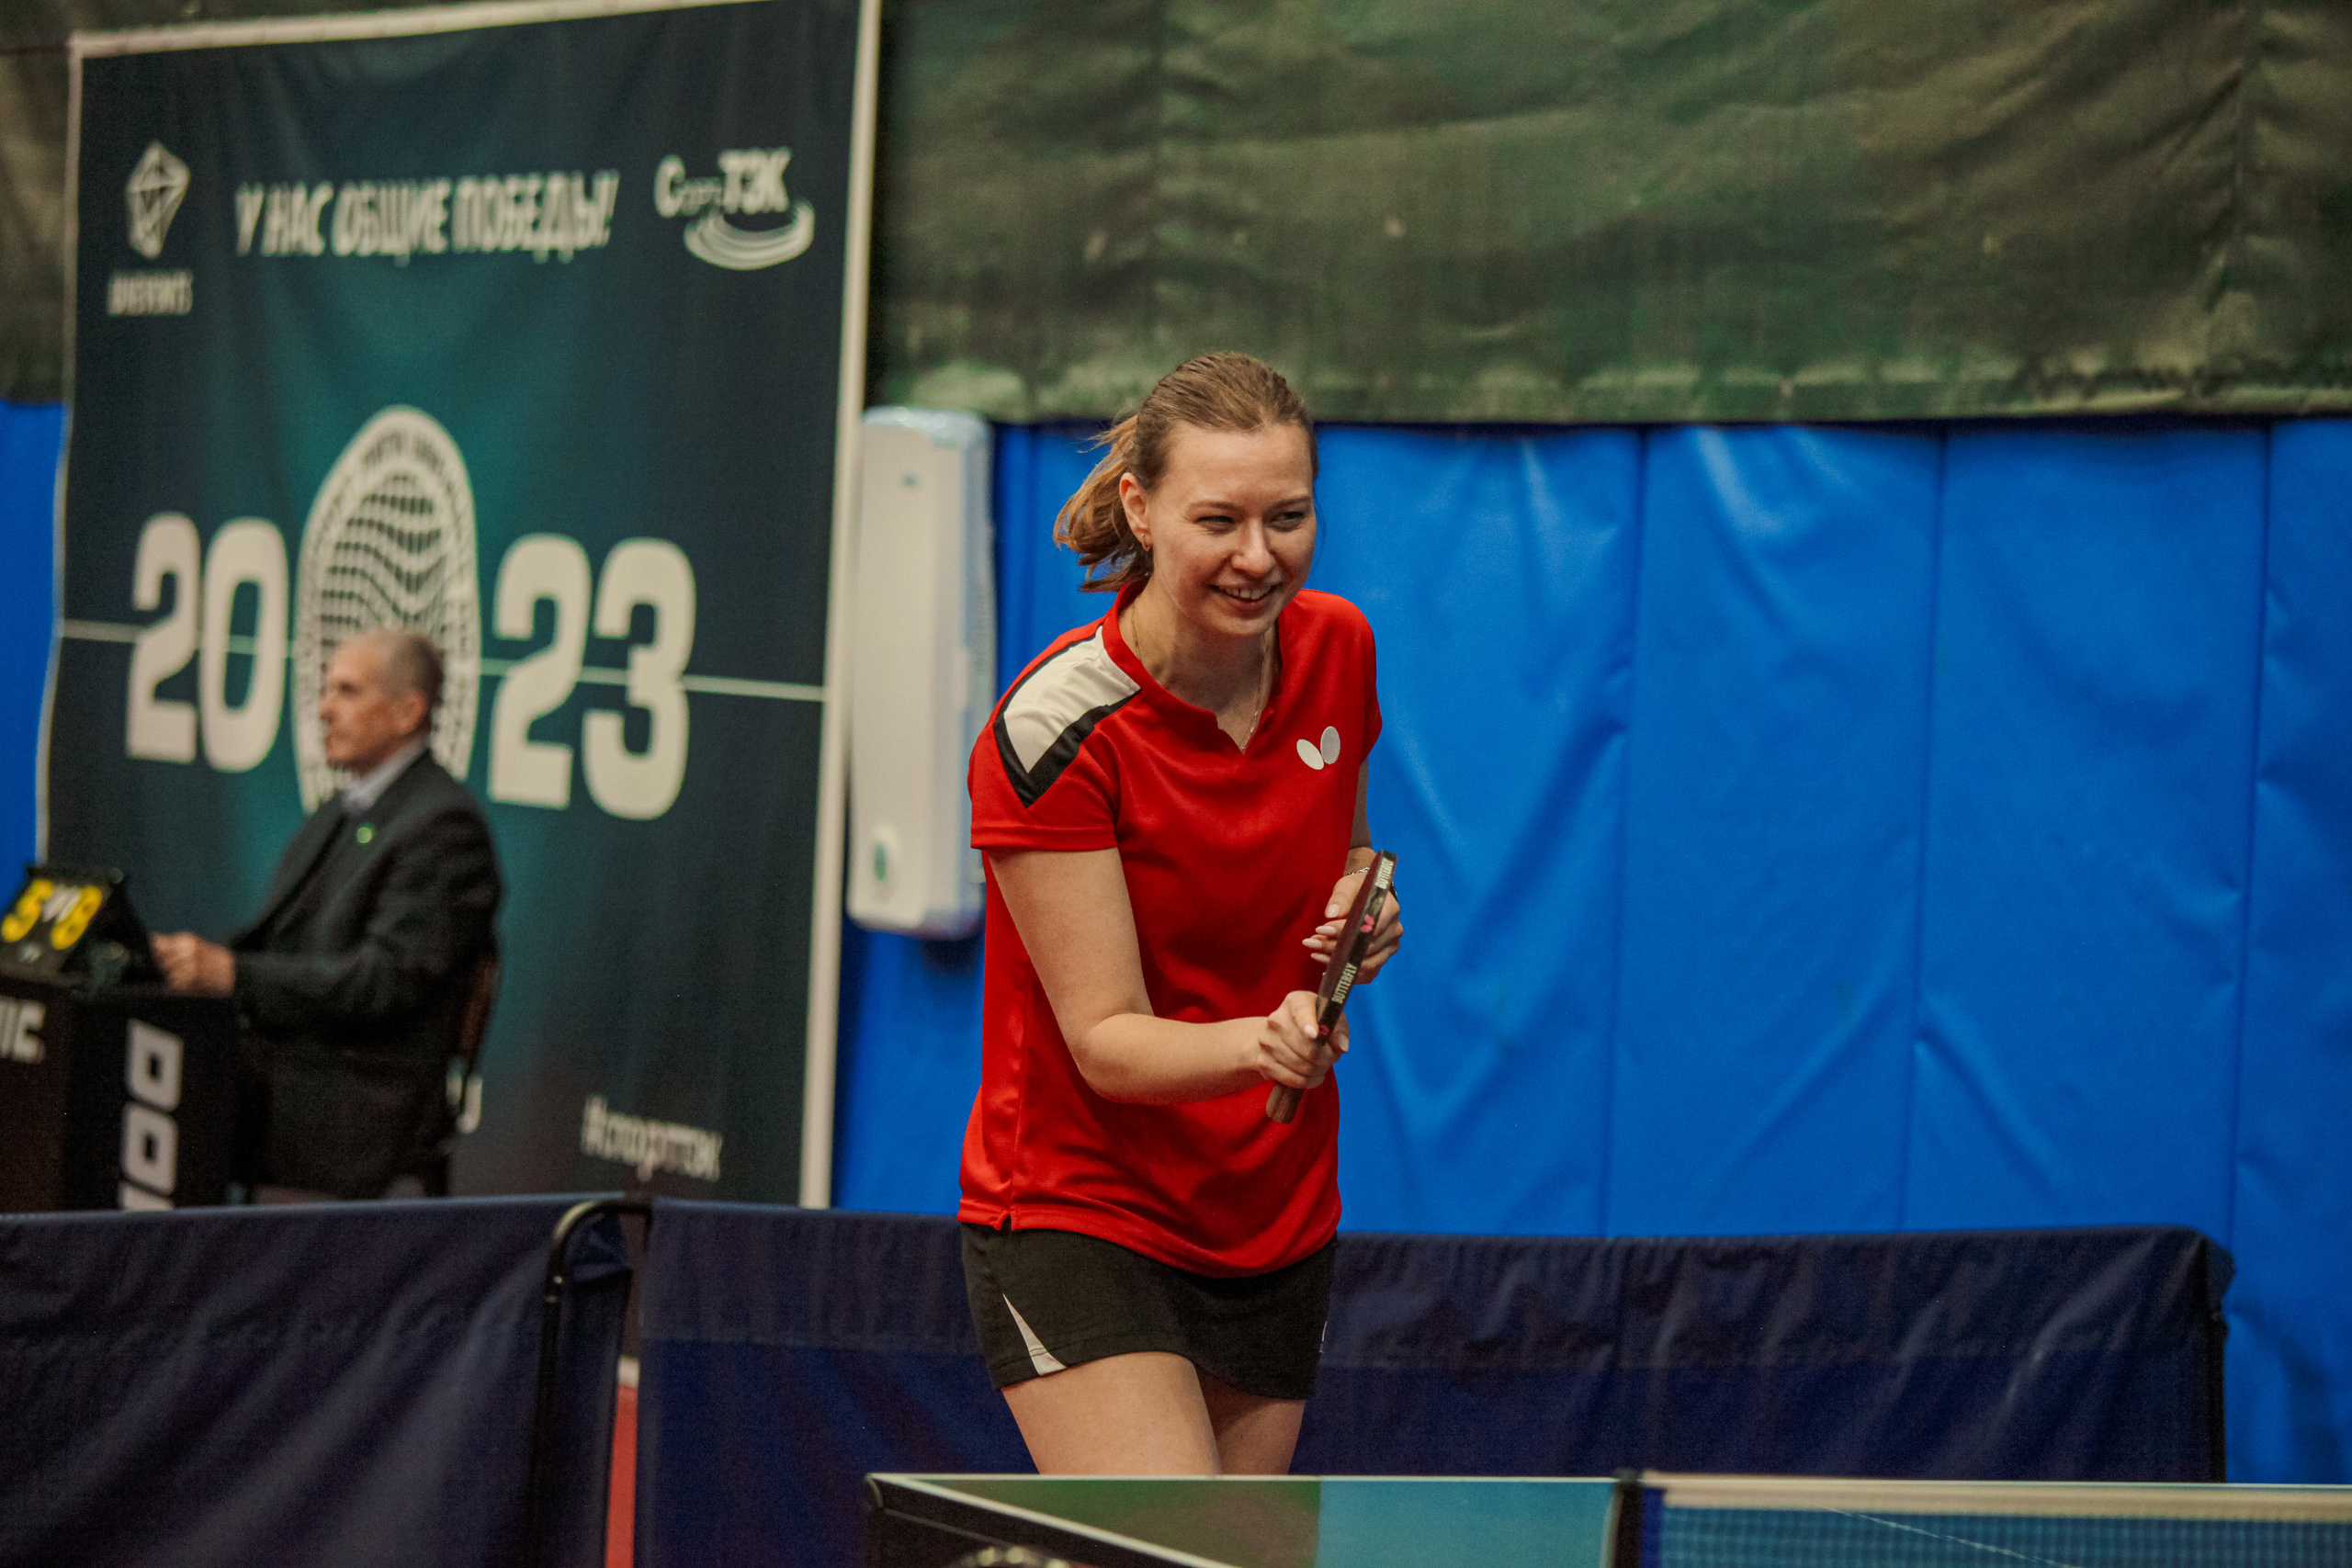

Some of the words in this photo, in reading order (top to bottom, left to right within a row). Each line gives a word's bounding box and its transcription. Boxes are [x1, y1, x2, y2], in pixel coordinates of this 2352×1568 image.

[261, 181, 334, 257] НАС
[332, 177, 451, 267] ОБЩИЕ
[451, 169, 619, 265] ПОБЕДЫ!
[1331, 962, 1358, 1004] BUTTERFLY
